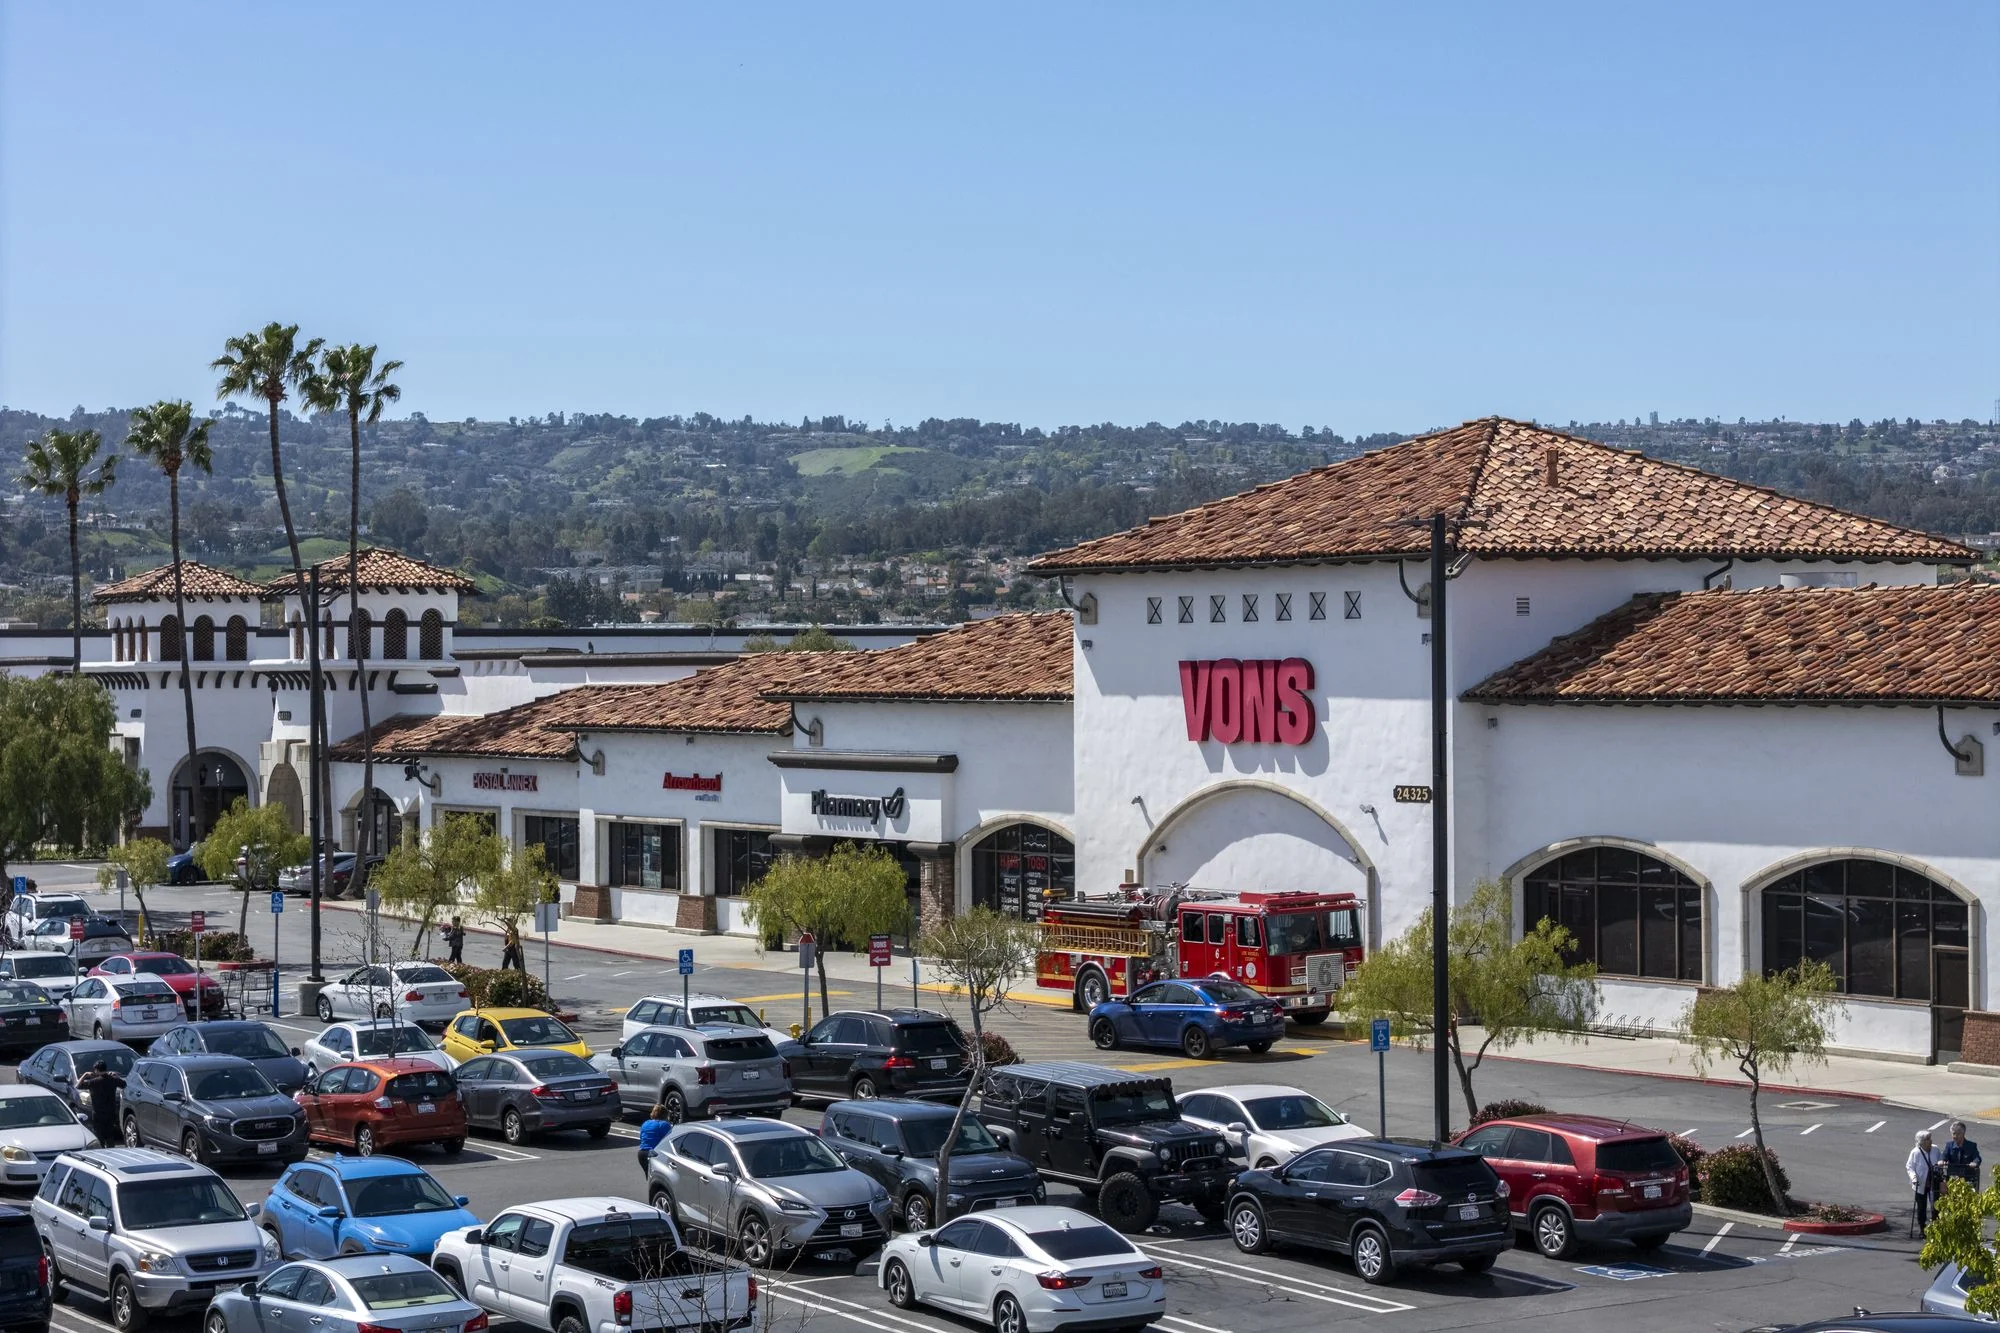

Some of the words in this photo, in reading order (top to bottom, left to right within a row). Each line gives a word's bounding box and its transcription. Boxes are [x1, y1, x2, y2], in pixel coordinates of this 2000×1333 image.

[1178, 657, 1316, 746] VONS
[473, 773, 504, 790] POSTAL
[506, 775, 538, 791] ANNEX
[663, 772, 721, 791] Arrowhead
[1396, 787, 1429, 801] 24325
[811, 789, 881, 825] Pharmacy
[1215, 948, 1220, 959] 6
[1319, 961, 1332, 986] 6
